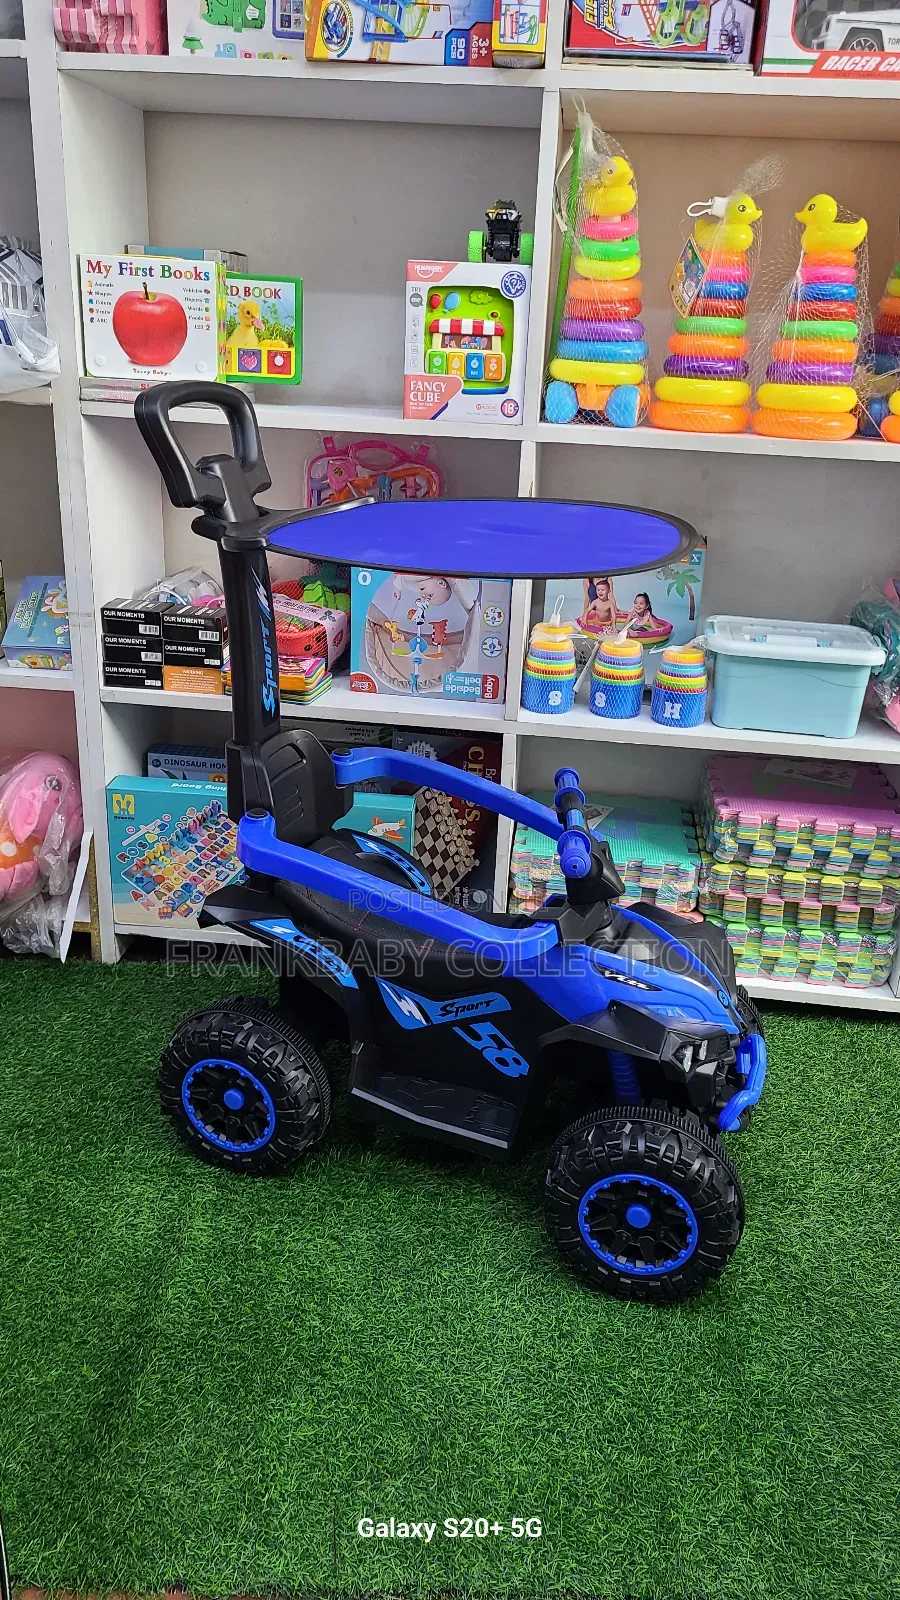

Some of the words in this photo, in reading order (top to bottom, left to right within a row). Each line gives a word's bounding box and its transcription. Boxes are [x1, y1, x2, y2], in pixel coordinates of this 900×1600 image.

[457, 38, 465, 59] 90
[479, 38, 489, 56] 3+
[821, 56, 881, 72] RACER
[86, 260, 112, 279] My
[118, 262, 154, 277] First
[160, 265, 210, 281] Books
[244, 286, 281, 299] BOOK
[410, 381, 447, 392] FANCY
[410, 392, 440, 402] CUBE
[178, 645, 205, 653] MOMENTS
[445, 684, 480, 694] Bedside
[484, 676, 496, 698] Baby
[663, 702, 682, 720] H
[164, 759, 207, 768] DINOSAUR
[436, 999, 497, 1018] Sport
[452, 1021, 529, 1077] 58
